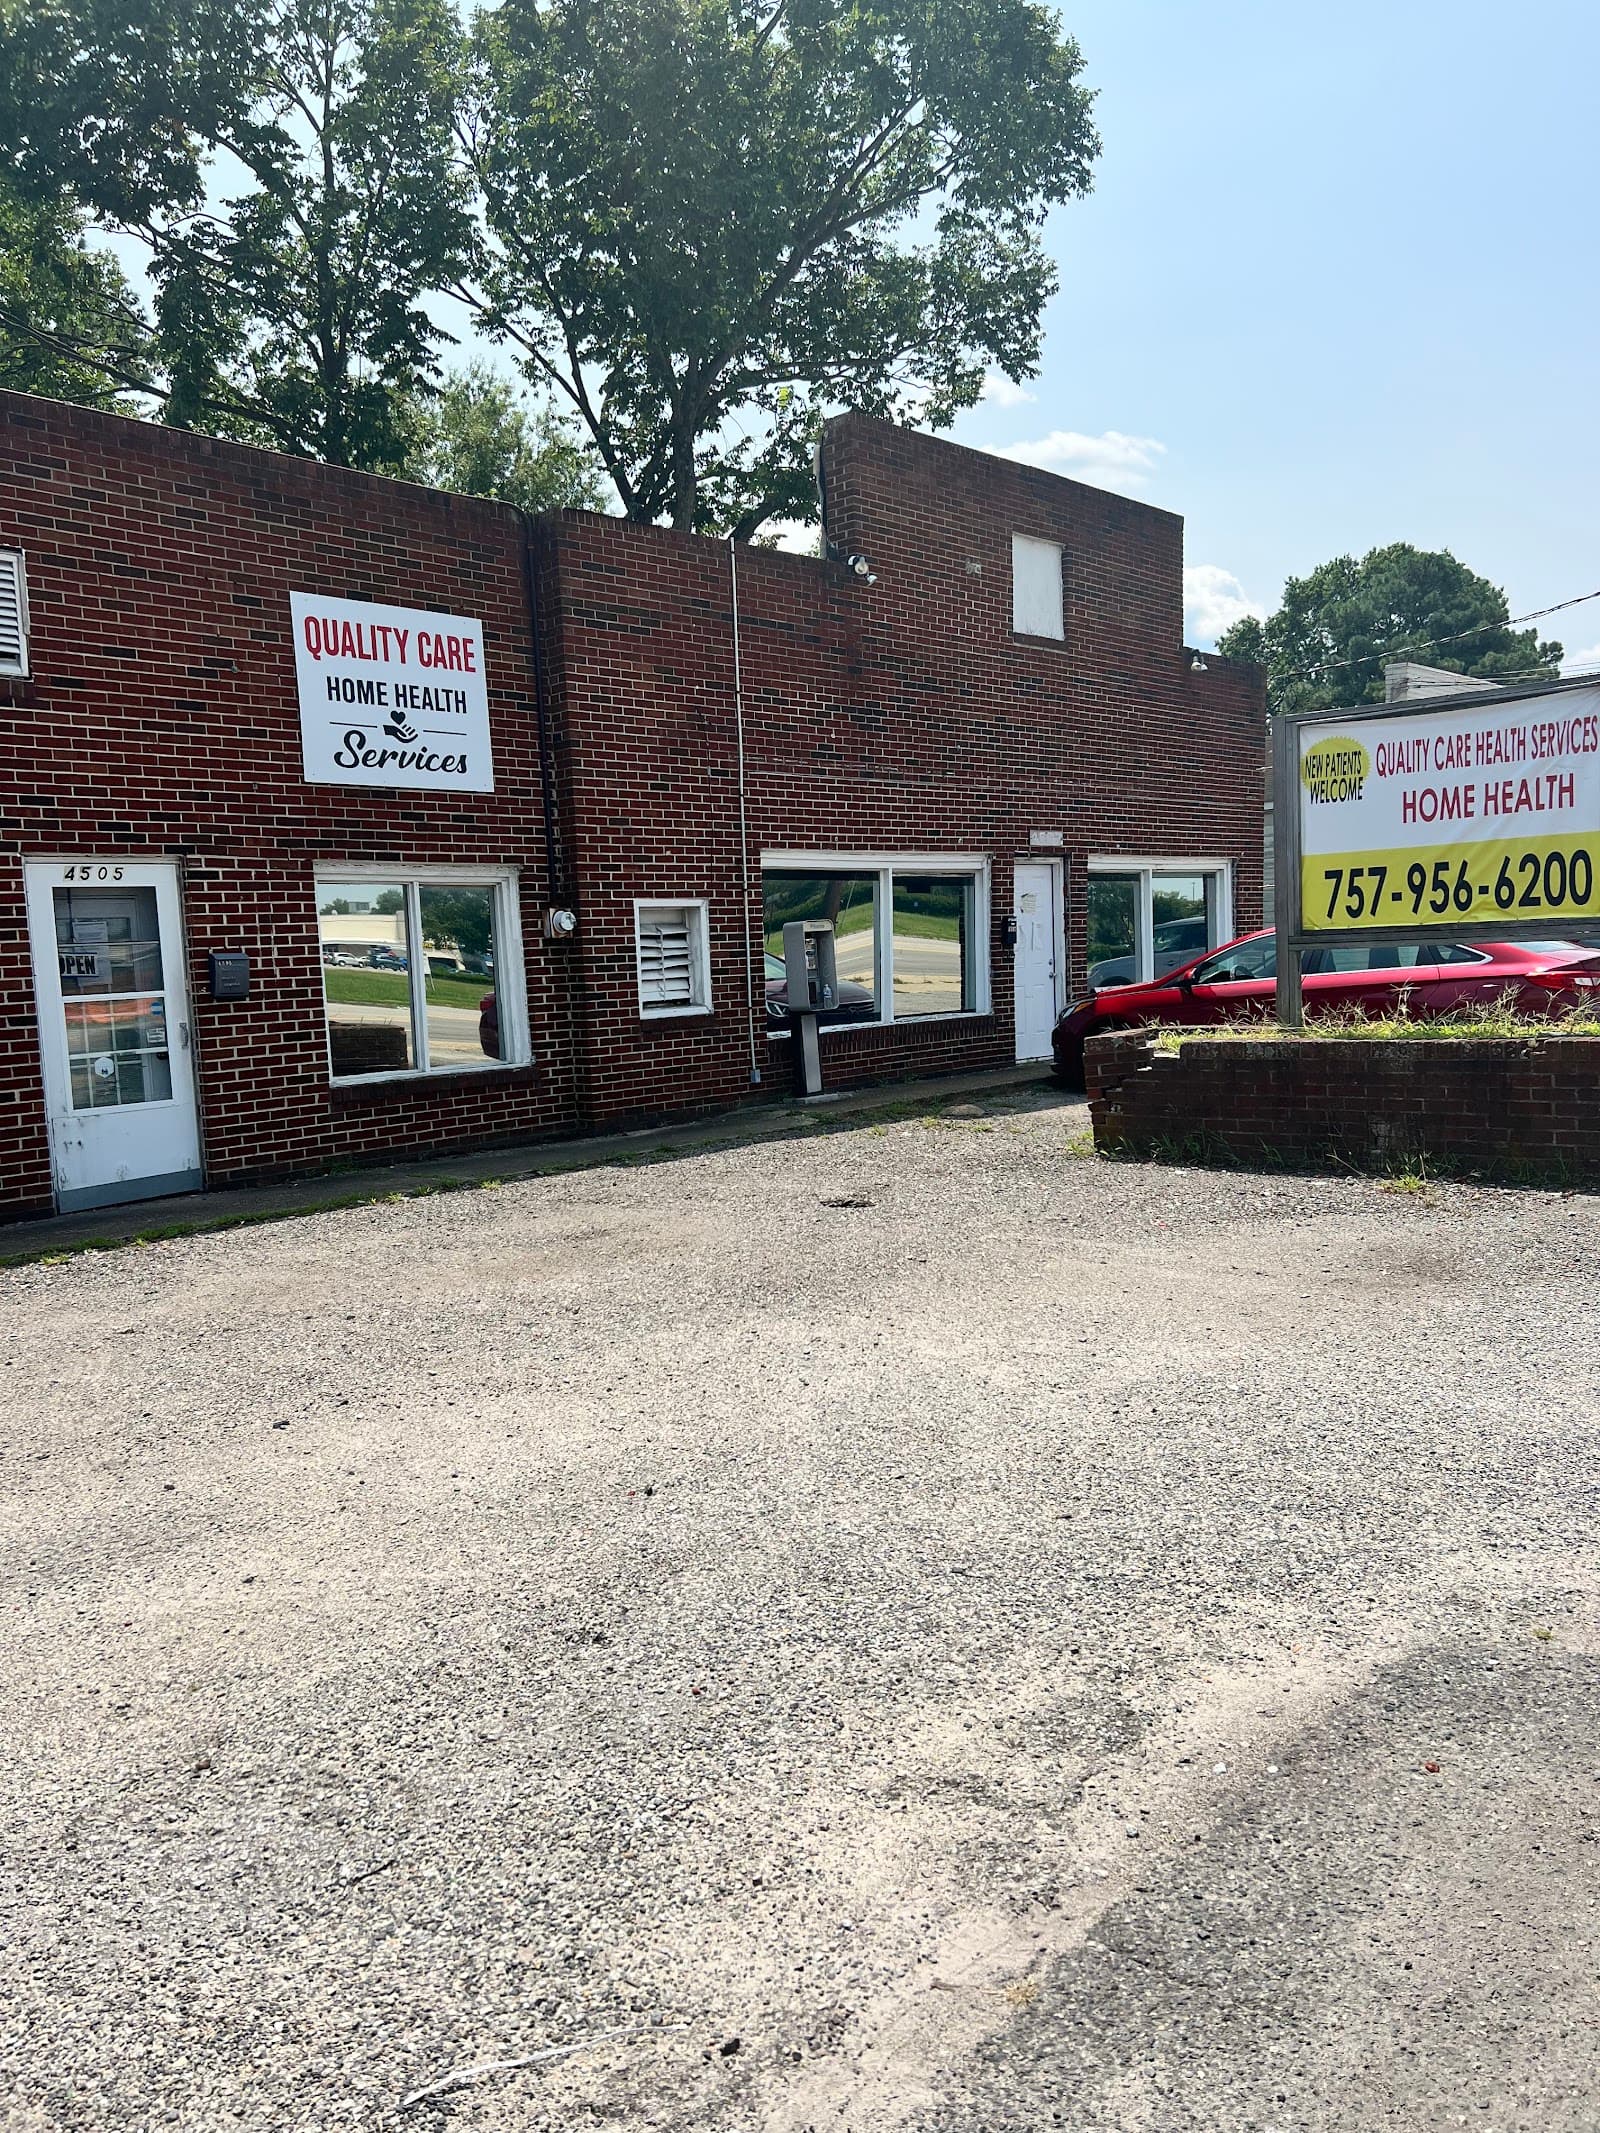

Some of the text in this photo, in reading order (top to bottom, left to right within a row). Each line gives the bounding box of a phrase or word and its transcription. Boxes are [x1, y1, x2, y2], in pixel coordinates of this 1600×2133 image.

[304, 615, 477, 673] QUALITY CARE
[326, 676, 467, 714] HOME HEALTH
[333, 729, 467, 774] Services
[1305, 750, 1362, 780] NEW PATIENTS
[1376, 715, 1598, 778] QUALITY CARE HEALTH SERVICES
[1310, 776, 1363, 804] WELCOME
[1402, 772, 1575, 823] HOME HEALTH
[65, 866, 124, 880] 4505
[1324, 849, 1593, 919] 757-956-6200
